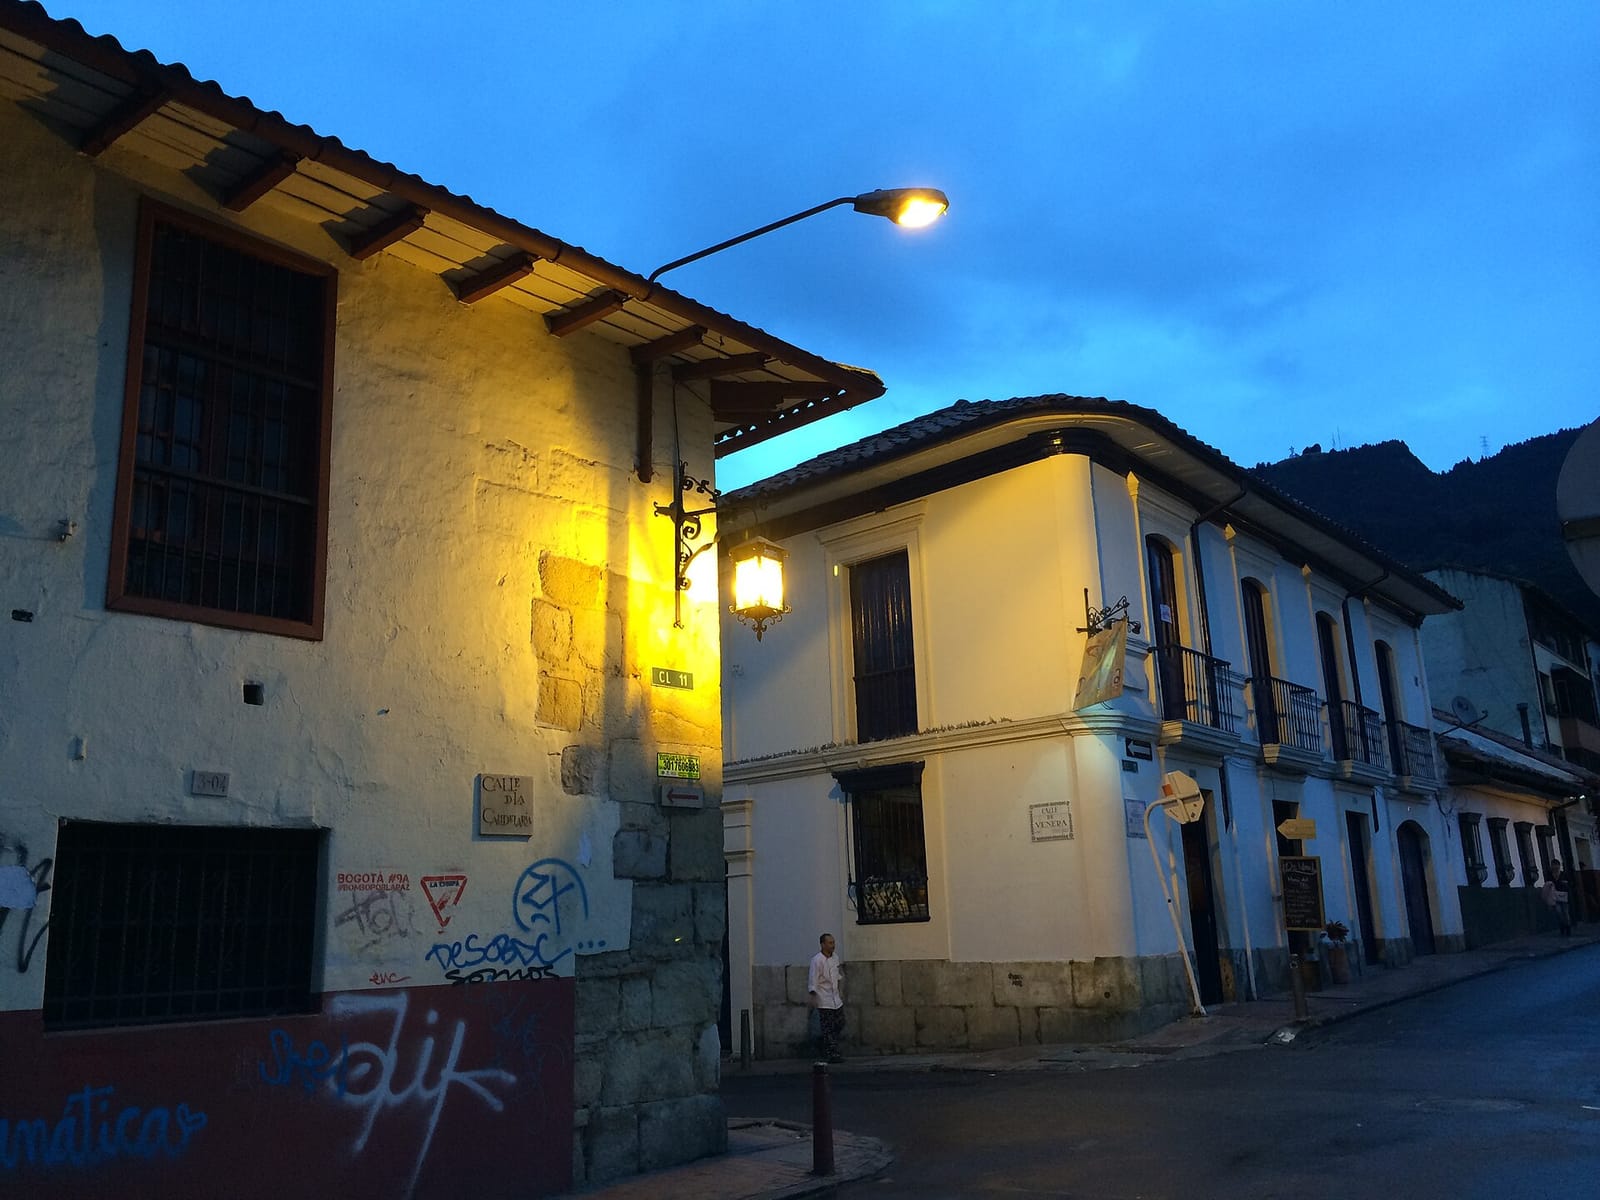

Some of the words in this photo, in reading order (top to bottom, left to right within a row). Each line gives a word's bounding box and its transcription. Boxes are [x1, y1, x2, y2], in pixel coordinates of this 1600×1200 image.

[659, 671, 671, 684] CL
[679, 673, 688, 687] 11
[482, 775, 520, 792] CALLE
